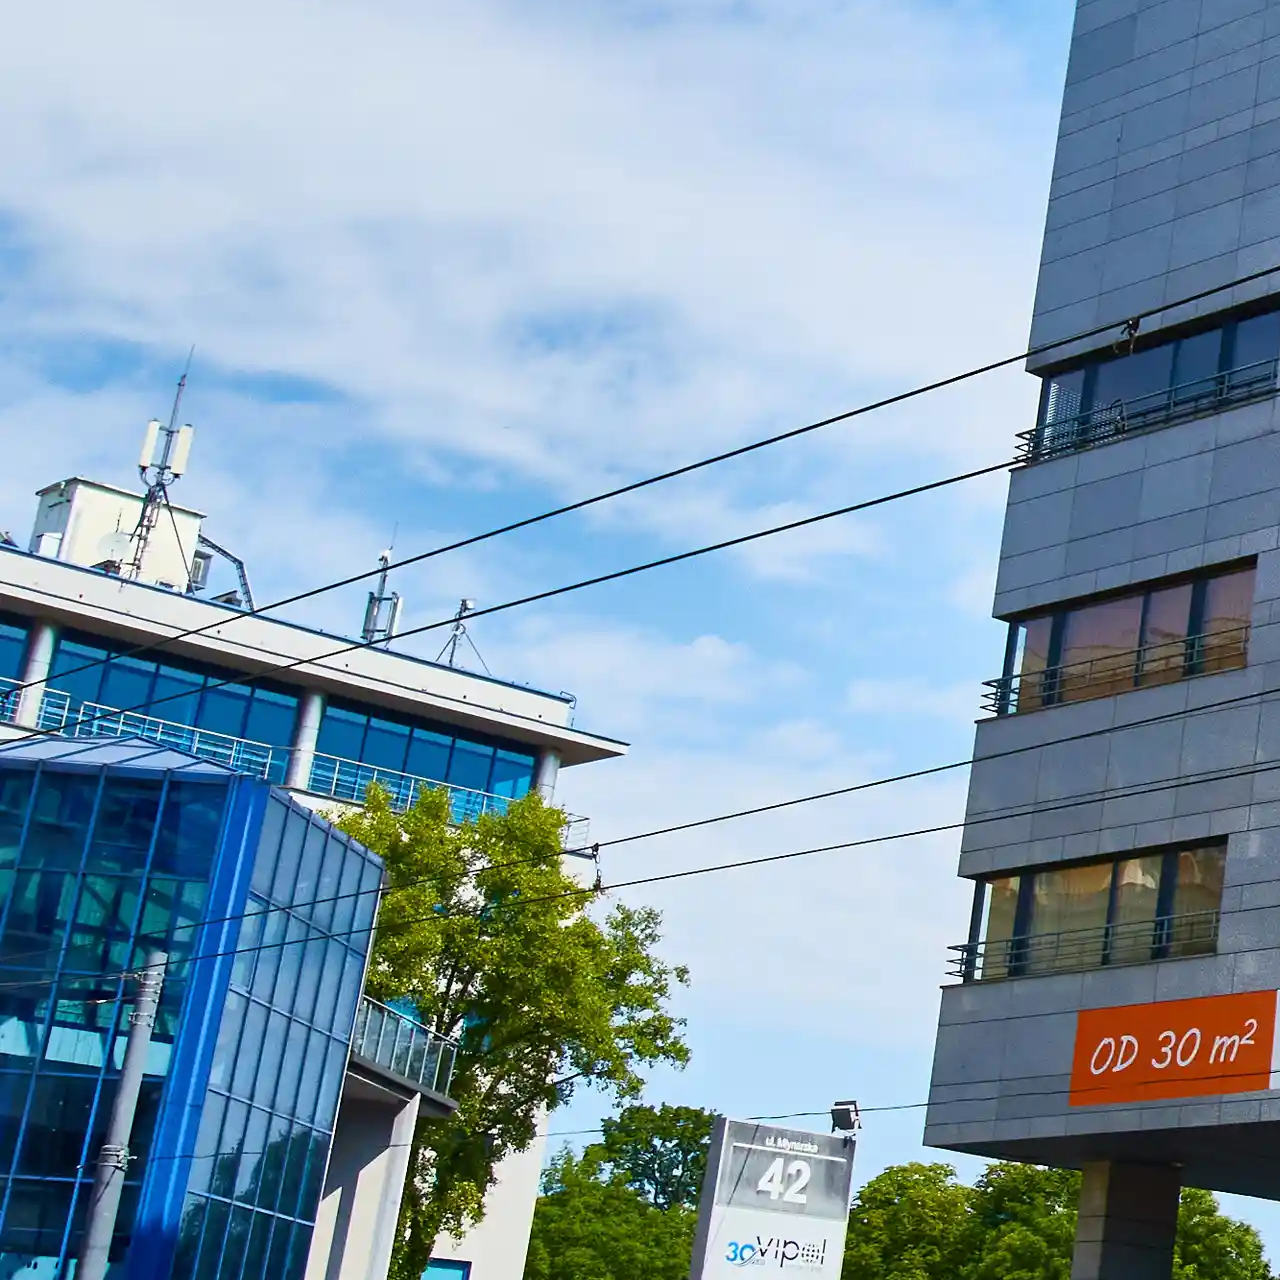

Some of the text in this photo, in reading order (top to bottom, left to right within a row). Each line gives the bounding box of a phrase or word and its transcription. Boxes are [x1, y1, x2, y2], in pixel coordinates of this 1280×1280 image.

[1090, 1034, 1139, 1075] OD
[1151, 1027, 1202, 1069] 30
[756, 1157, 812, 1204] 42
